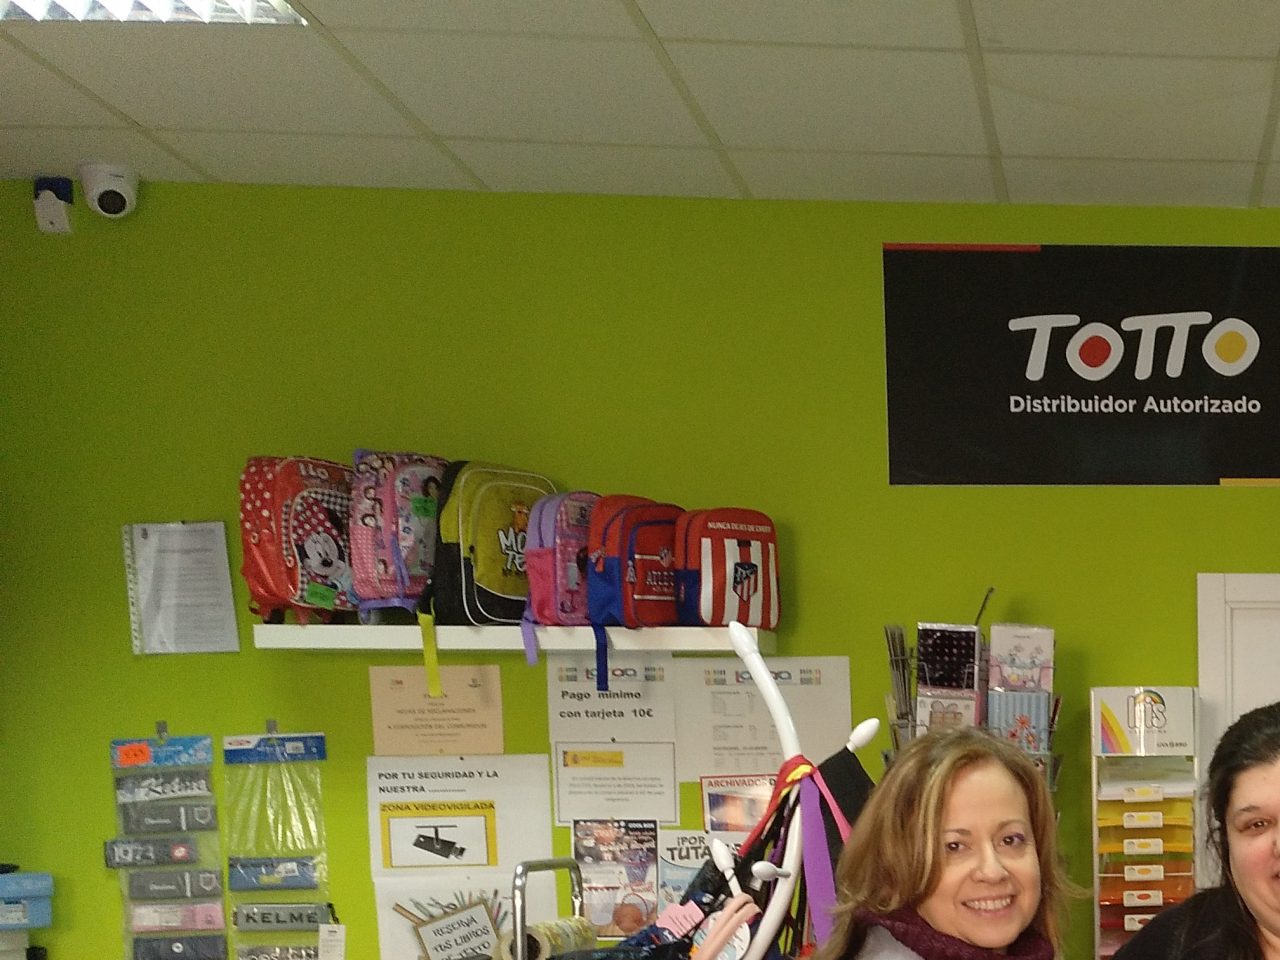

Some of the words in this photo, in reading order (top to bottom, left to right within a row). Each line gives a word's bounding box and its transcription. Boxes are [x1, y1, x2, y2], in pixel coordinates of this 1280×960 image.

[1008, 311, 1261, 382] TOTTO
[1009, 395, 1137, 415] Distribuidor
[1143, 395, 1262, 415] Autorizado
[561, 690, 592, 701] Pago
[559, 710, 581, 718] con
[585, 708, 625, 719] tarjeta
[632, 708, 654, 718] 10€
[378, 772, 398, 780] POR
[402, 772, 415, 780] TU
[418, 771, 475, 780] SEGURIDAD
[477, 770, 484, 778] Y
[486, 770, 498, 778] LA
[379, 785, 426, 793] NUESTRA
[381, 804, 411, 812] ZONA
[414, 803, 496, 811] VIDEOVIGILADA
[245, 911, 318, 924] KELME
[432, 915, 478, 937] RESERVA
